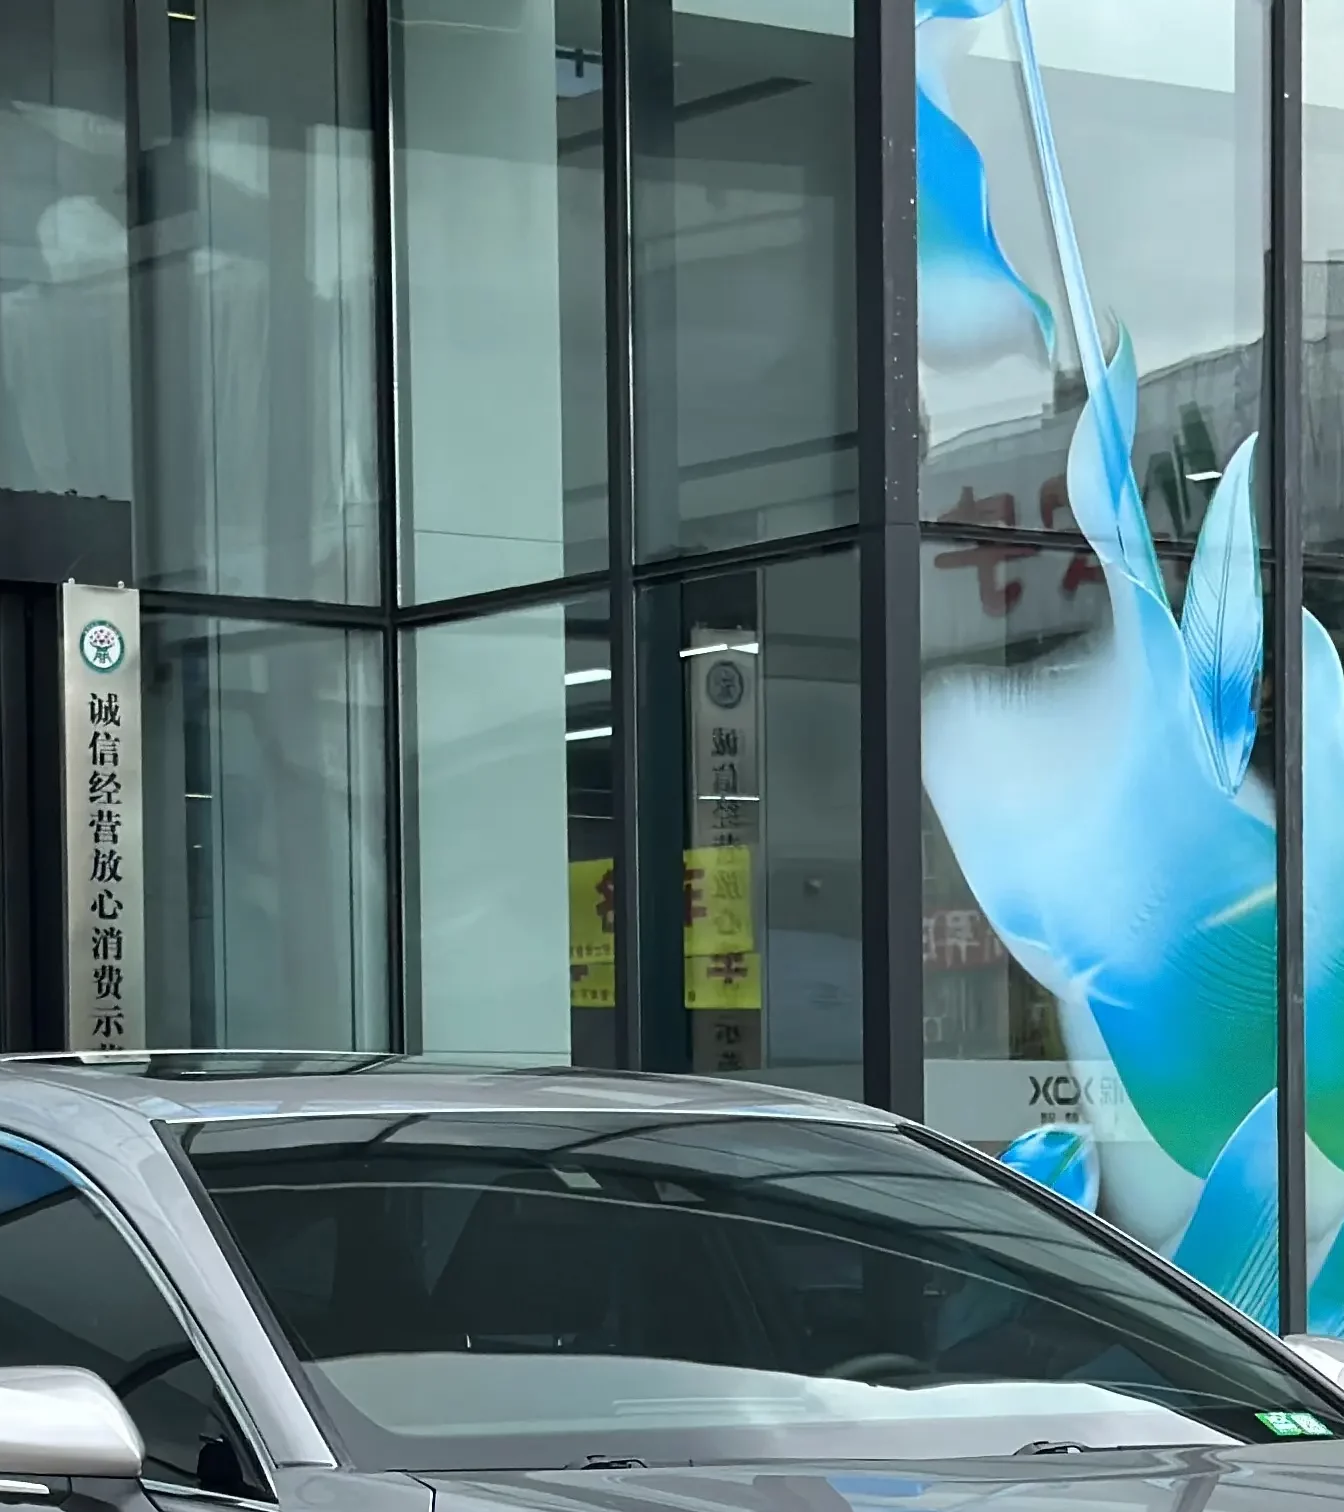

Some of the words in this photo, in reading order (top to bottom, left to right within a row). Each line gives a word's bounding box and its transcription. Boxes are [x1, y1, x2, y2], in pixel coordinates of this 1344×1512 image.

[87, 692, 125, 1051] 诚信经营放心消费示
